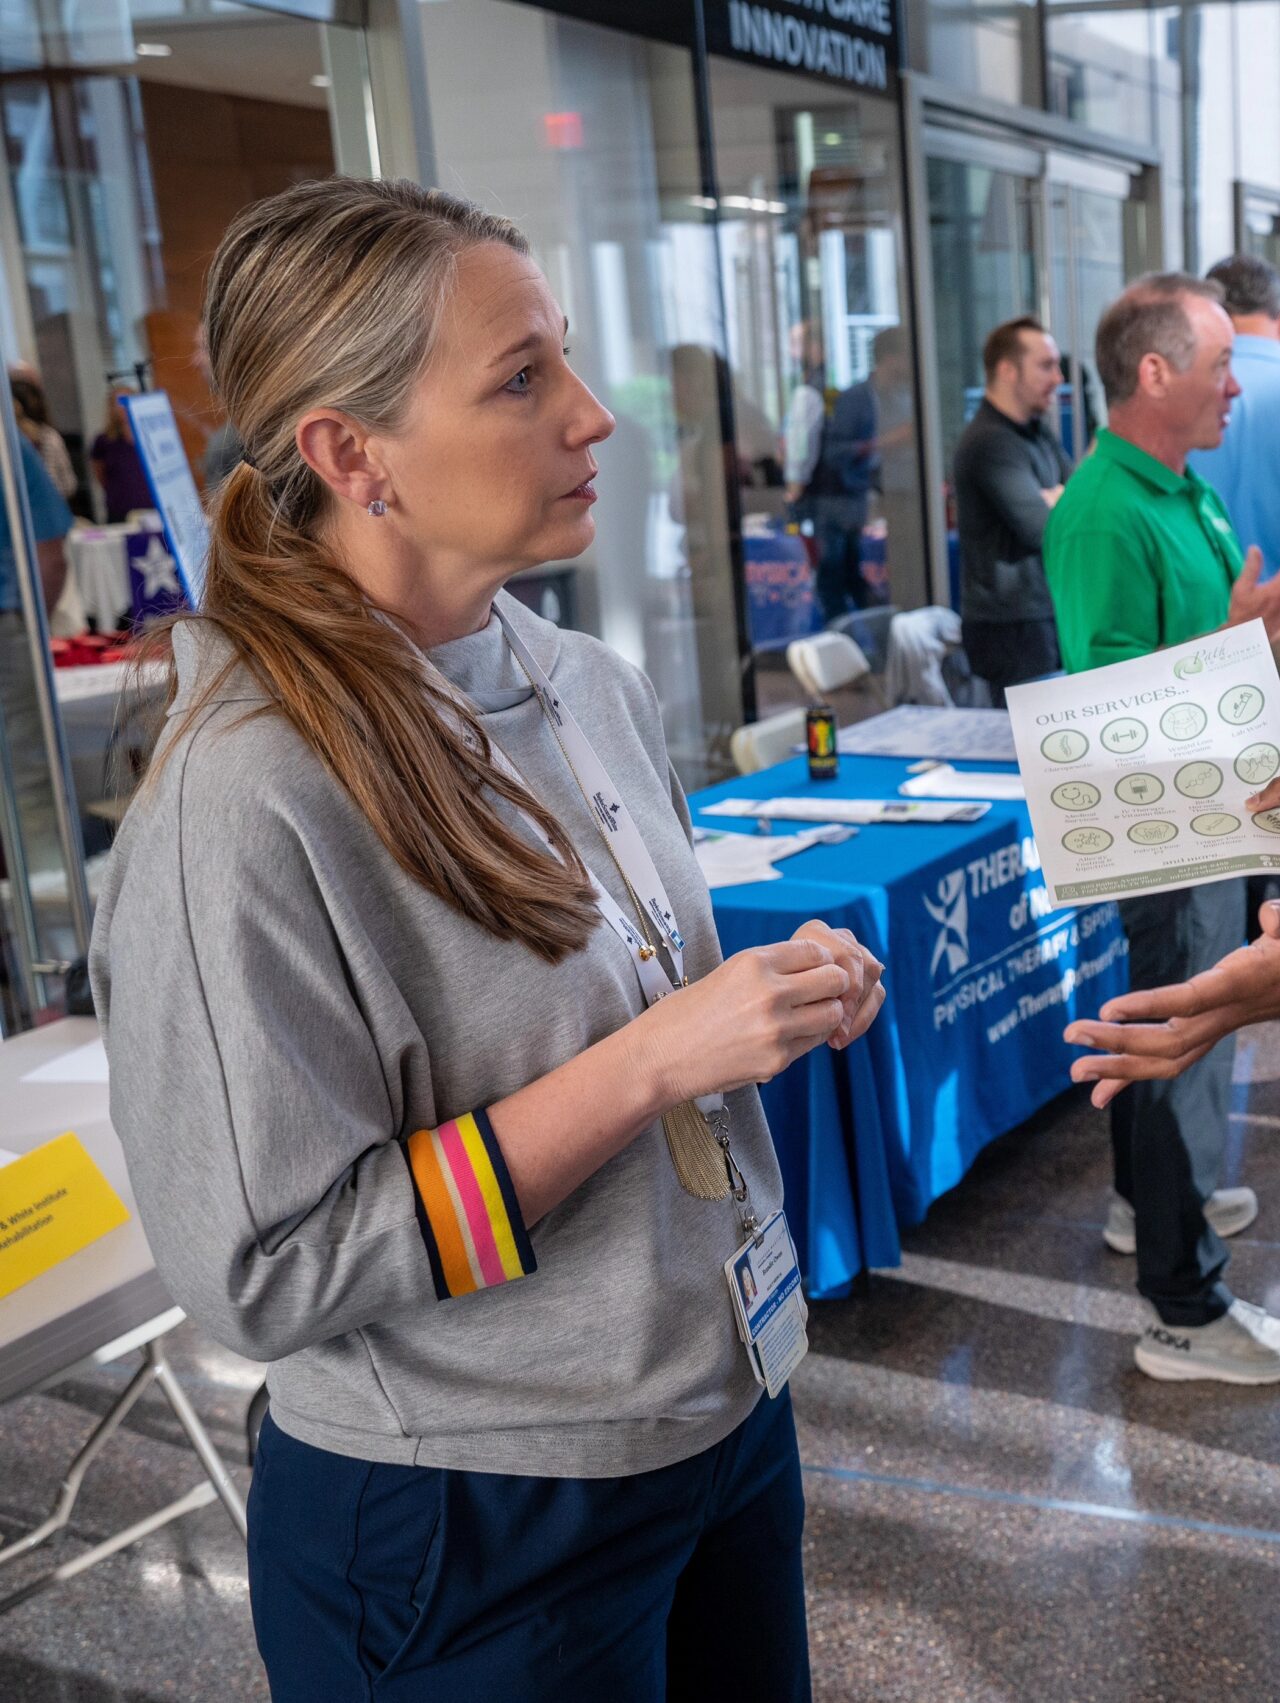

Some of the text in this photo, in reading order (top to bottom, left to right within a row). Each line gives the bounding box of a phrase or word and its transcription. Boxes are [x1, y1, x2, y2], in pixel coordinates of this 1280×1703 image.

[728, 0, 887, 90] INNOVATION
[1036, 709, 1077, 726] OUR
[933, 966, 1007, 1032] PHYSICAL
[1006, 926, 1069, 982] THERAPY
[8, 1208, 33, 1225] White
[33, 1188, 68, 1210] Institute
[751, 1301, 777, 1337] CONTRACTOR
[778, 1292, 785, 1303] NO
[784, 1275, 800, 1295] ESCORT
[1147, 1324, 1191, 1351] HOKA
